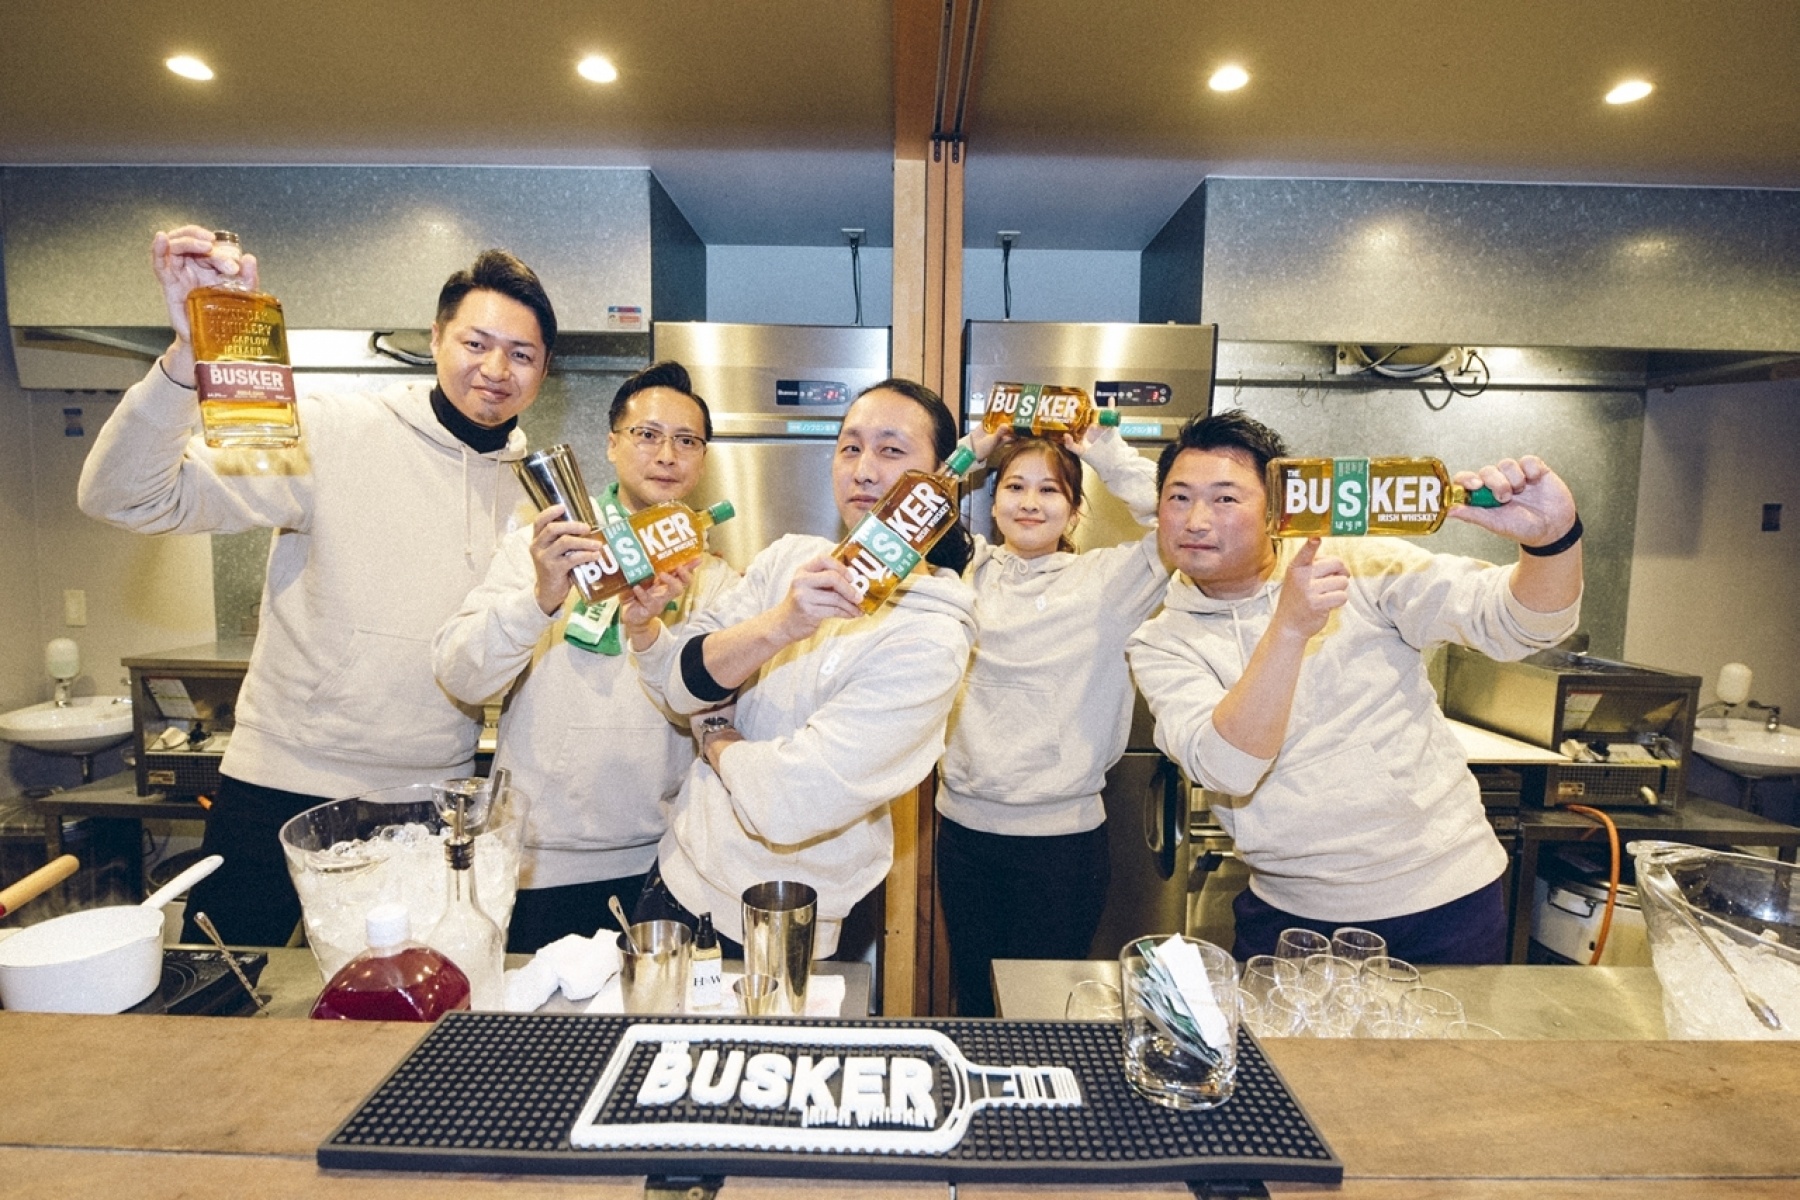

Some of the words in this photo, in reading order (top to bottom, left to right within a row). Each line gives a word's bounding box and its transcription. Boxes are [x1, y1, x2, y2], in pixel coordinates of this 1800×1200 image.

[210, 368, 284, 388] BUSKER
[991, 391, 1079, 419] BUSKER
[1286, 476, 1441, 518] BUSKER
[1378, 513, 1399, 522] IRISH
[1401, 513, 1438, 522] WHISKEY
[637, 1050, 937, 1112] BUSKER
